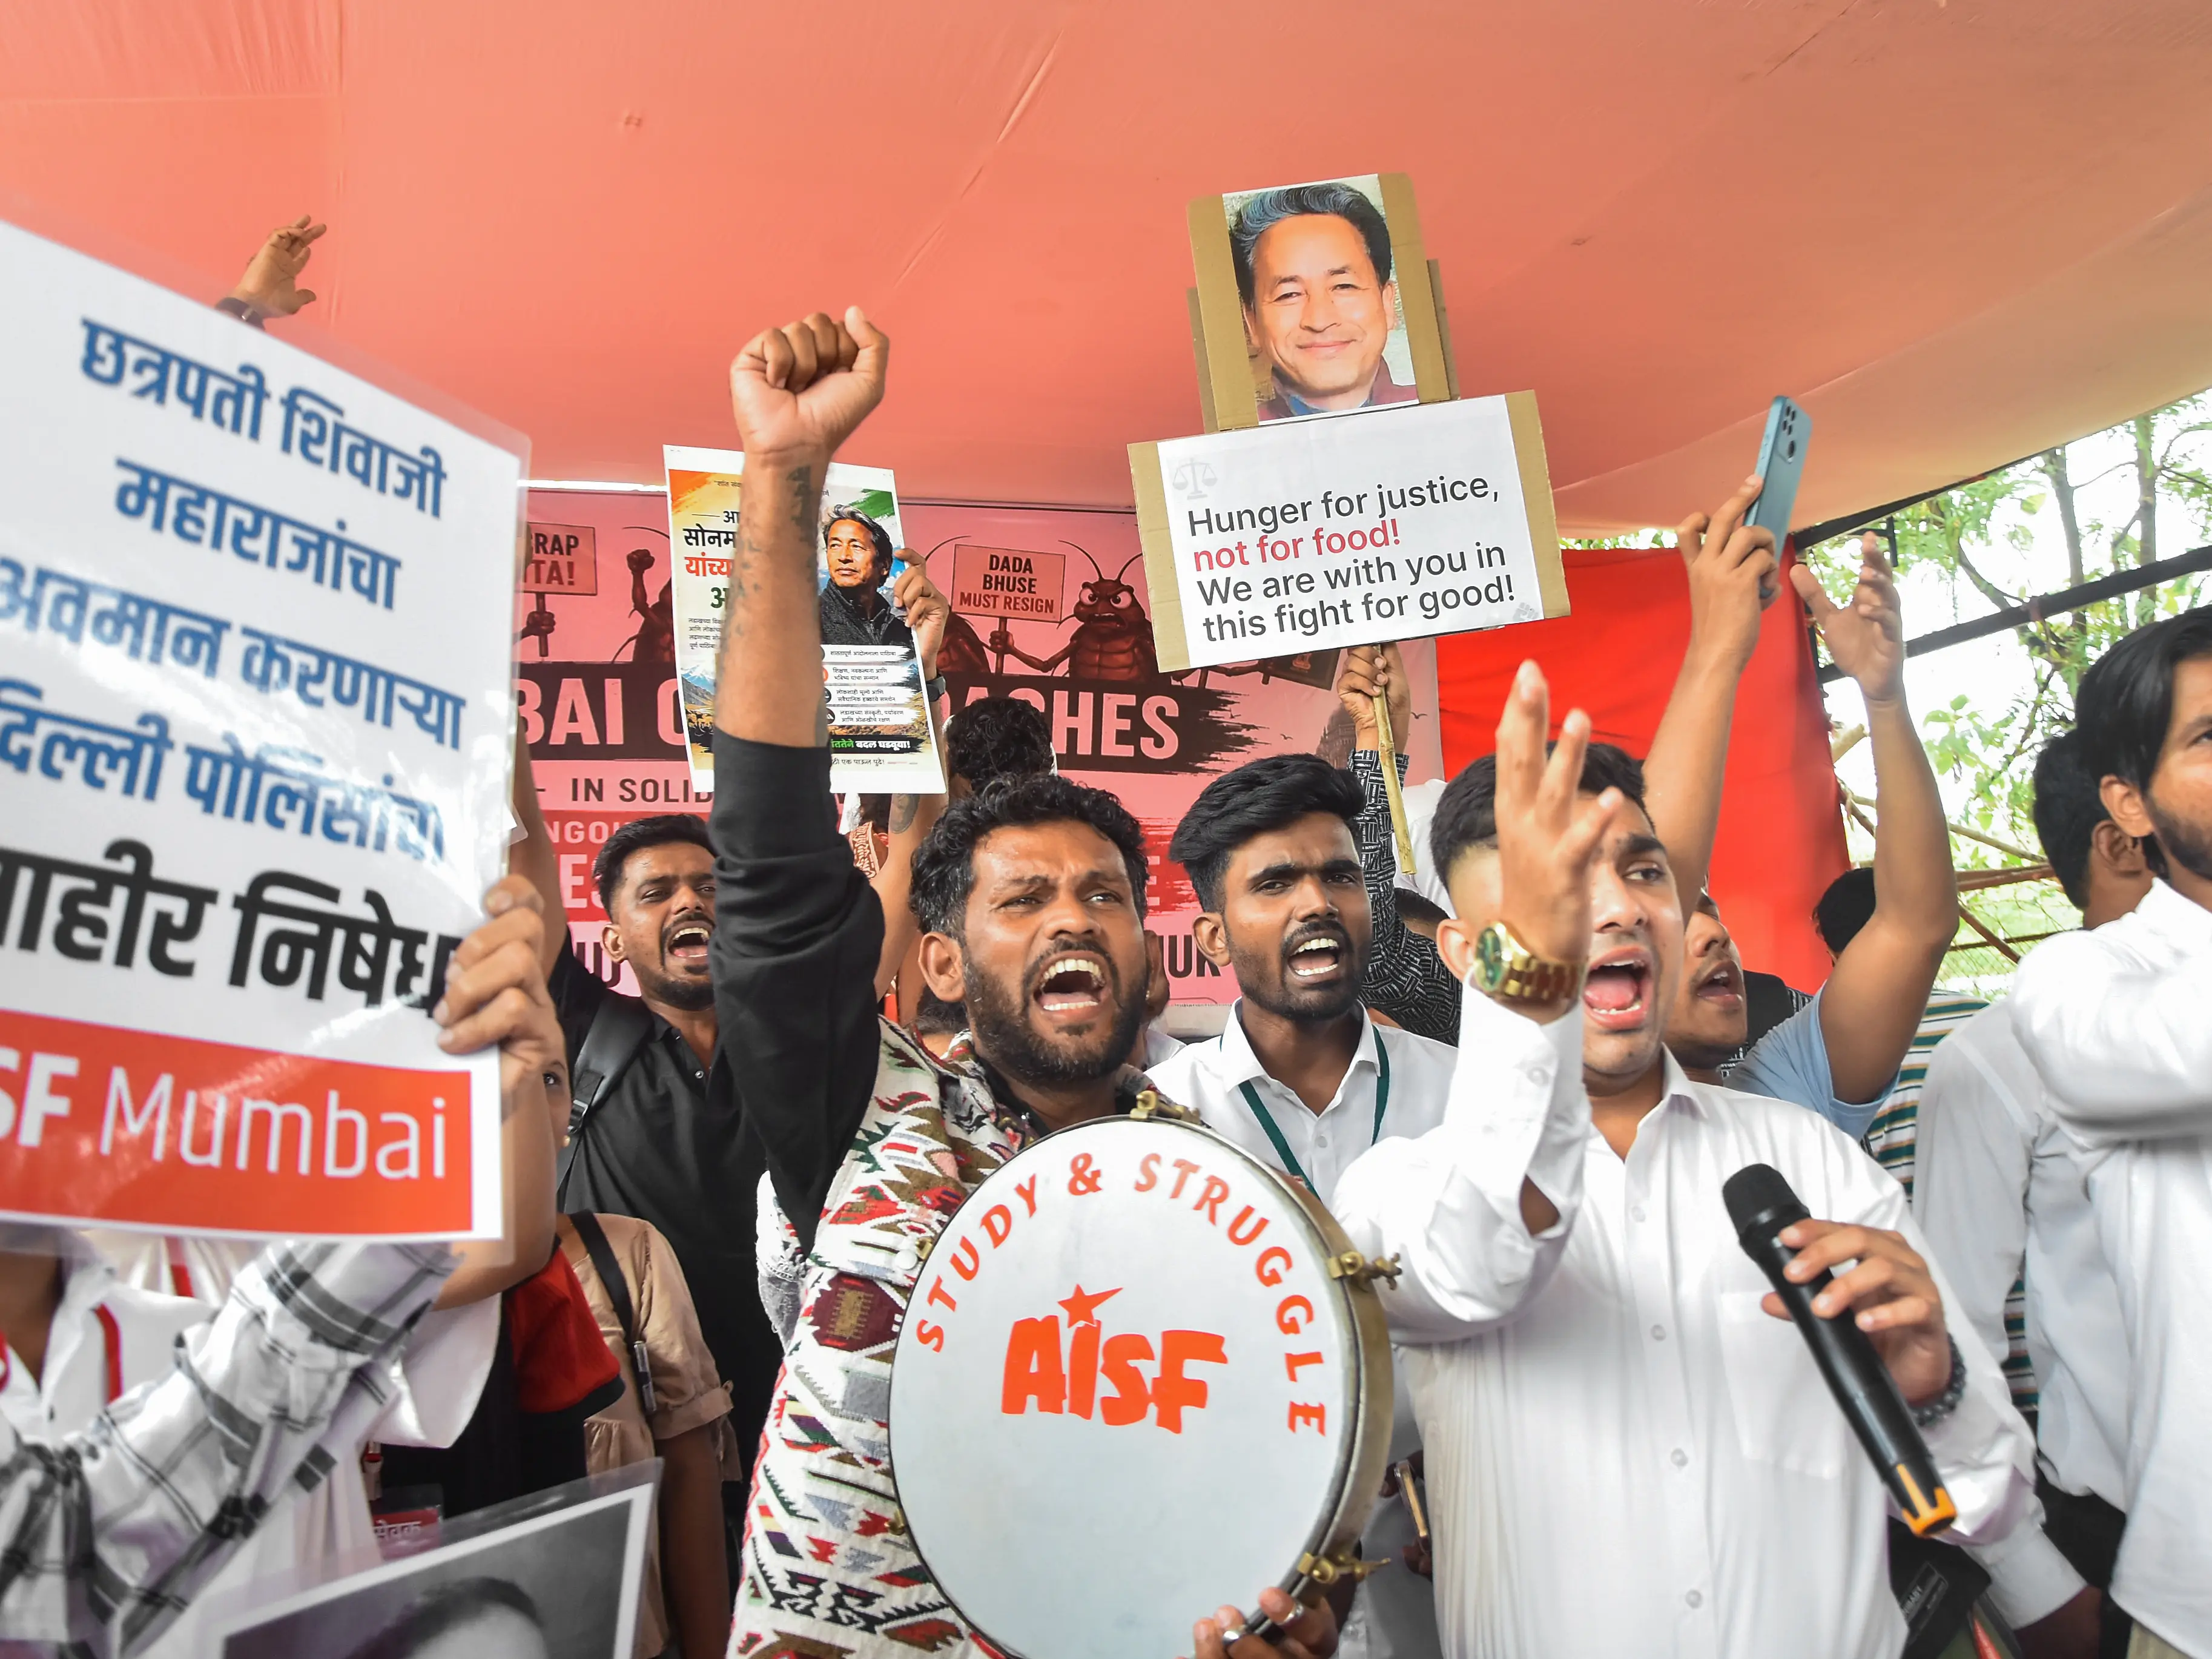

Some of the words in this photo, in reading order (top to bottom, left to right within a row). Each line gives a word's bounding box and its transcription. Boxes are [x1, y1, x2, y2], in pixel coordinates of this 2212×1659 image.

[81, 316, 270, 443] छत्रपती
[279, 386, 449, 519] शिवाजी
[114, 457, 402, 612] महाराजांचा
[1187, 499, 1313, 537] Hunger
[1321, 490, 1368, 519] for
[1378, 475, 1500, 519] justice,
[989, 554, 1034, 575] DADA
[1193, 541, 1249, 572] not
[1256, 530, 1304, 564] for
[1312, 518, 1401, 556] food!
[1197, 573, 1252, 606] We
[1262, 571, 1315, 598] are
[1324, 556, 1396, 590] with
[1405, 549, 1467, 586] you
[1477, 541, 1507, 569] in
[960, 592, 1000, 609] MUST
[1003, 595, 1055, 614] RESIGN
[982, 574, 1038, 595] BHUSE
[1203, 610, 1267, 642] this
[1275, 596, 1353, 636] fight
[1361, 592, 1410, 621] for
[1418, 574, 1516, 621] good!
[0, 557, 231, 679] अवमान
[571, 778, 604, 802] IN
[99, 1064, 447, 1180] Mumbai
[916, 1173, 1038, 1353] STUDY
[1068, 1153, 1102, 1196] &
[1134, 1153, 1327, 1437] STRUGGLE
